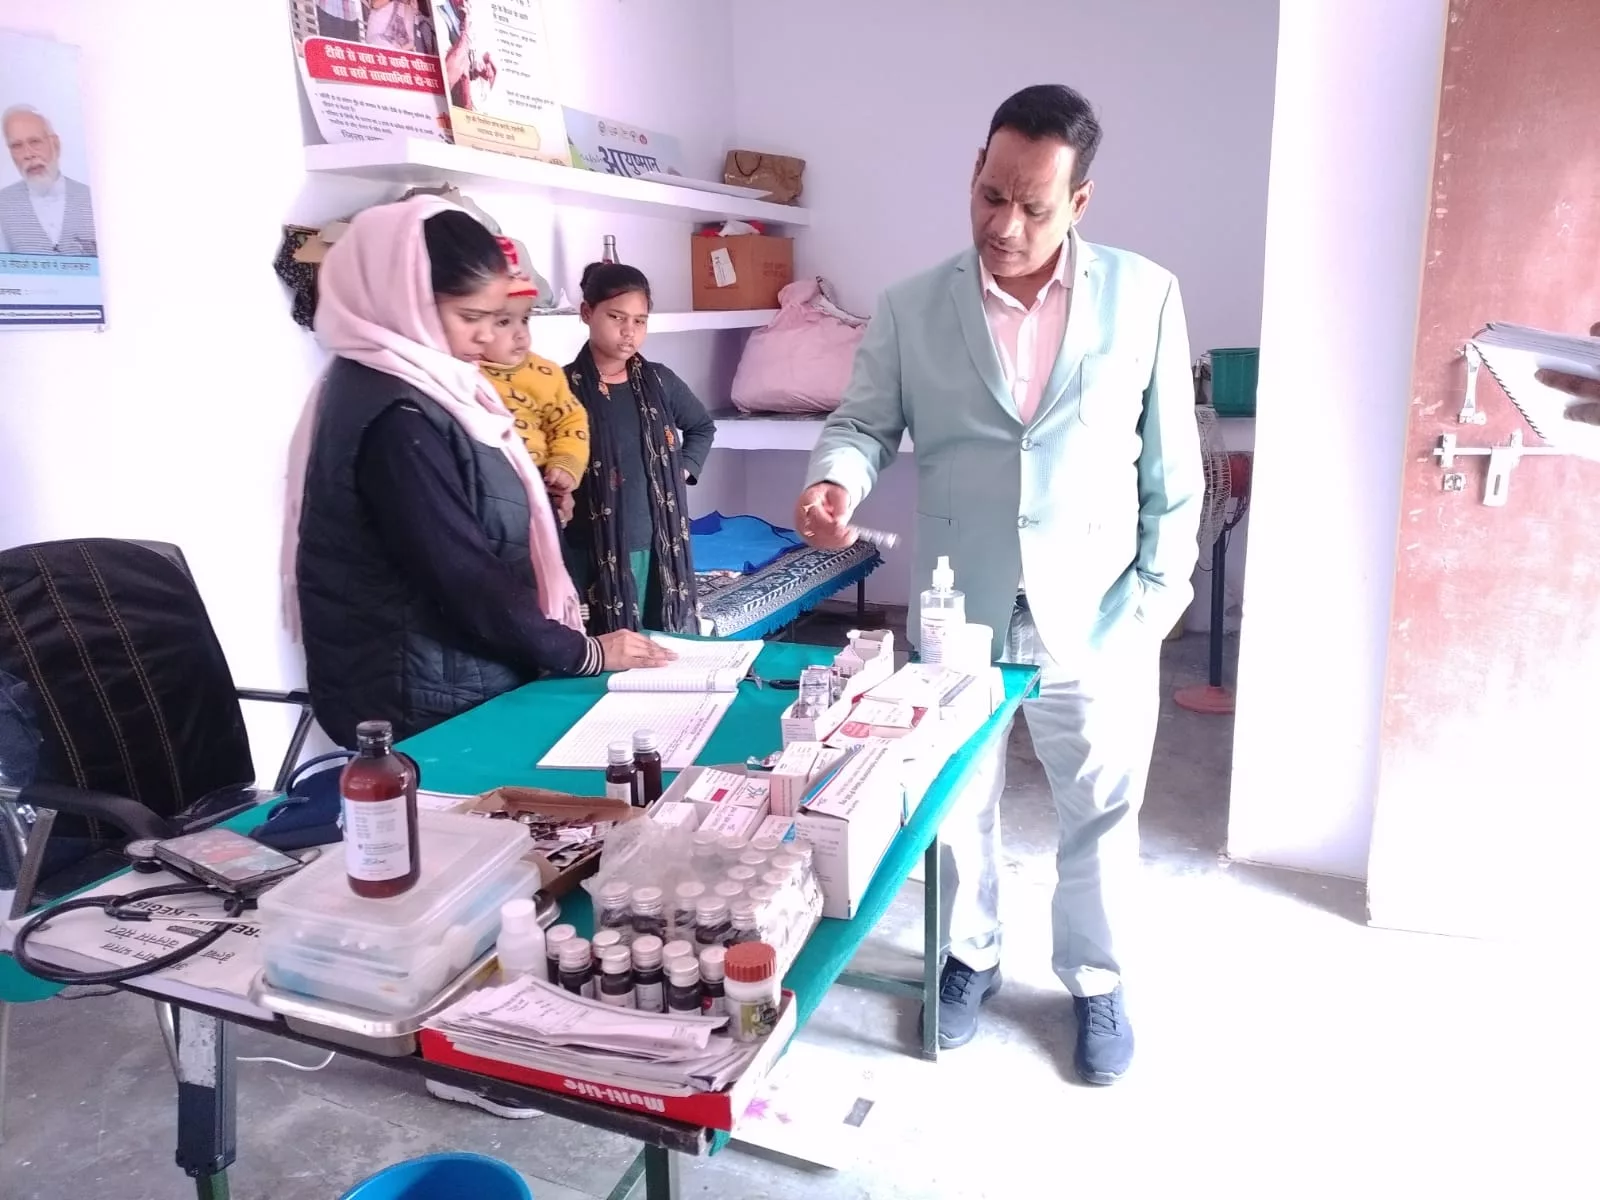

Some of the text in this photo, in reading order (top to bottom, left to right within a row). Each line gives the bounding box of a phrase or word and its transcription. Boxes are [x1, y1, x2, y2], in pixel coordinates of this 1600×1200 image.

[347, 48, 356, 61] से
[598, 146, 660, 178] आयुष्मान
[563, 1079, 665, 1112] Multi-Life
